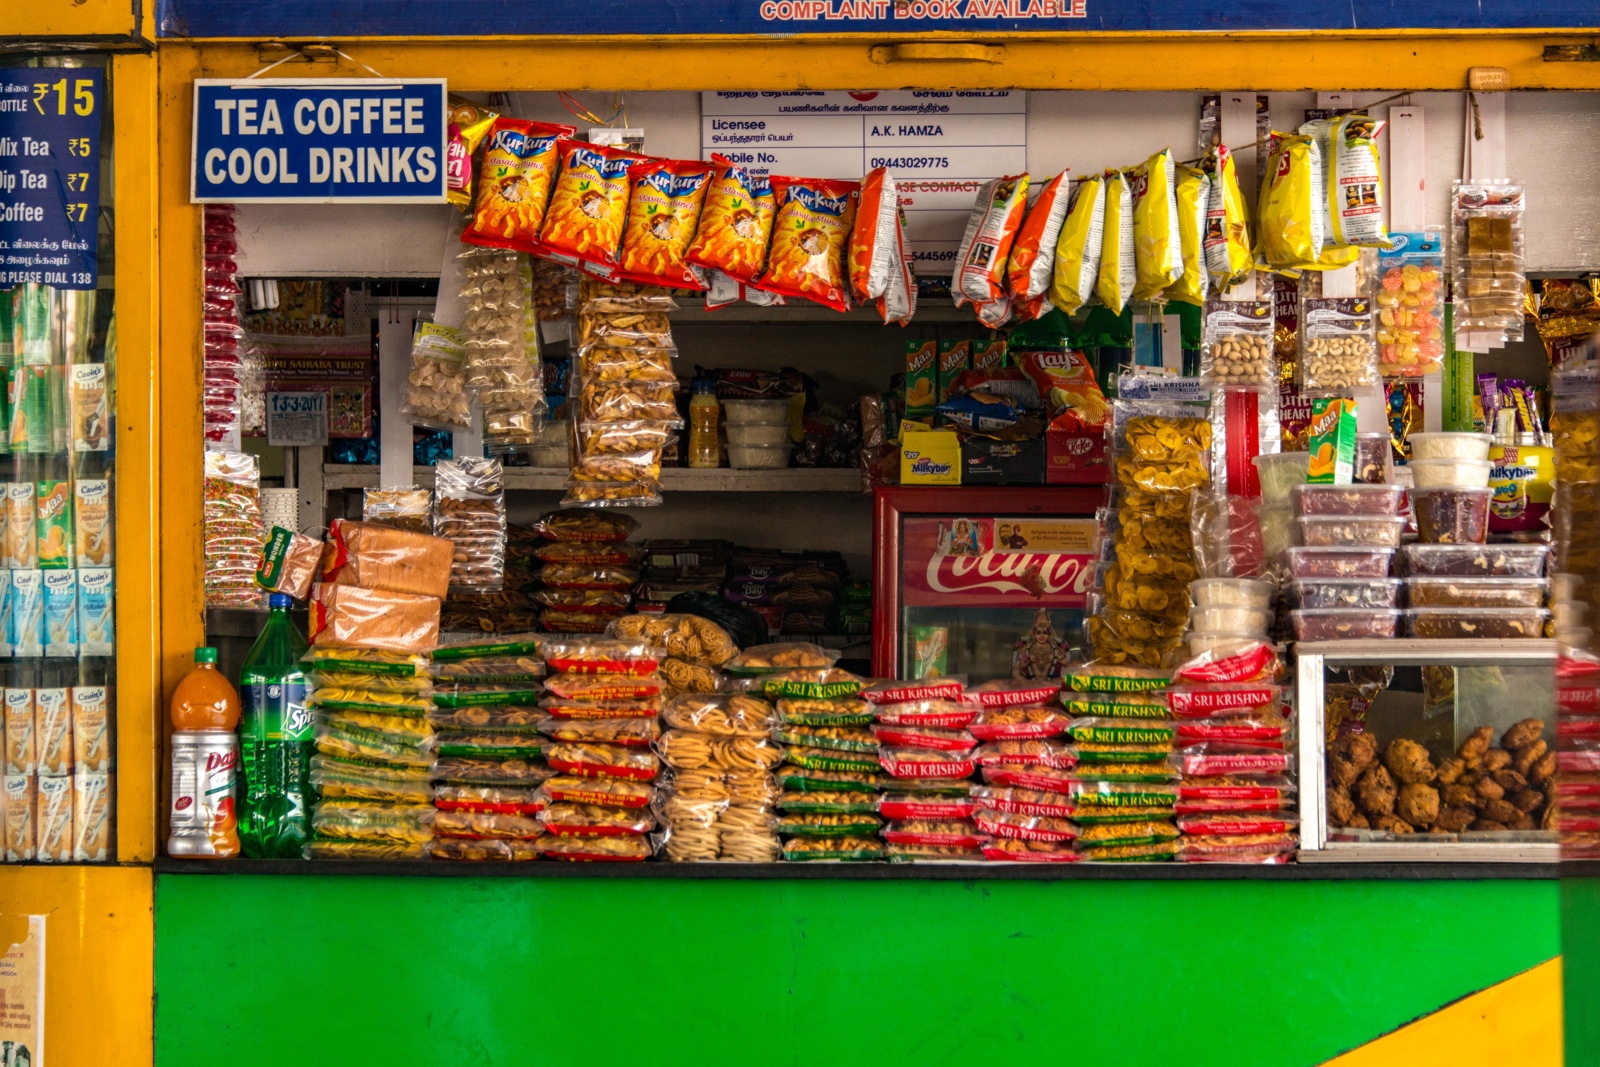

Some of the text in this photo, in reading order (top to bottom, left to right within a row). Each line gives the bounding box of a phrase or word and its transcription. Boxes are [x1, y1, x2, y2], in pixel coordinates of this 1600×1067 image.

[760, 0, 1087, 20] COMPLAINT BOOK AVAILABLE
[214, 98, 424, 135] TEA COFFEE
[712, 120, 766, 130] Licensee
[870, 125, 944, 137] A.K. HAMZA
[22, 136, 50, 156] Tea
[496, 130, 554, 154] Kurkure
[757, 152, 778, 163] No.
[870, 158, 949, 168] 09443029775
[204, 148, 298, 184] COOL
[309, 146, 436, 184] DRINKS
[20, 169, 47, 189] Tea
[896, 182, 978, 192] ASE CONTACT
[788, 186, 849, 213] Kurkure
[0, 202, 44, 222] Coffee
[816, 216, 844, 230] Munch
[8, 272, 92, 284] PLEASE DIAL 138
[290, 360, 366, 370] SAIBABA TRUST
[908, 349, 932, 372] Maa
[942, 349, 965, 372] Maa
[976, 350, 1000, 370] Maa
[1038, 353, 1080, 372] Lay's
[76, 367, 102, 379] Cavin's
[1314, 410, 1337, 436] Maa
[912, 464, 951, 474] Milkybar
[80, 482, 107, 494] Cavin's
[40, 494, 63, 518] Maa
[269, 533, 284, 561] WONDER
[48, 572, 72, 584] Cavin's
[83, 572, 109, 584] Cavin's
[786, 682, 858, 698] SRI KRISHNA
[1093, 679, 1166, 692] SRI KRISHNA
[9, 692, 28, 703] Cavin's
[78, 690, 104, 701] Cavin's
[887, 686, 959, 700] SRI KRISHNA
[1194, 693, 1269, 706] SRI KRISHNA
[983, 694, 1001, 706] SRI
[1091, 704, 1165, 717] SRI KRISHNA
[1095, 730, 1169, 742] SRI KRISHNA
[808, 758, 826, 770] SRI
[899, 762, 966, 776] SRI KRISHN
[7, 778, 26, 790] Cavin's
[1100, 794, 1173, 806] SRI KRISHNA
[998, 802, 1070, 817] SRI KRISHNA
[1000, 826, 1019, 838] SRI
